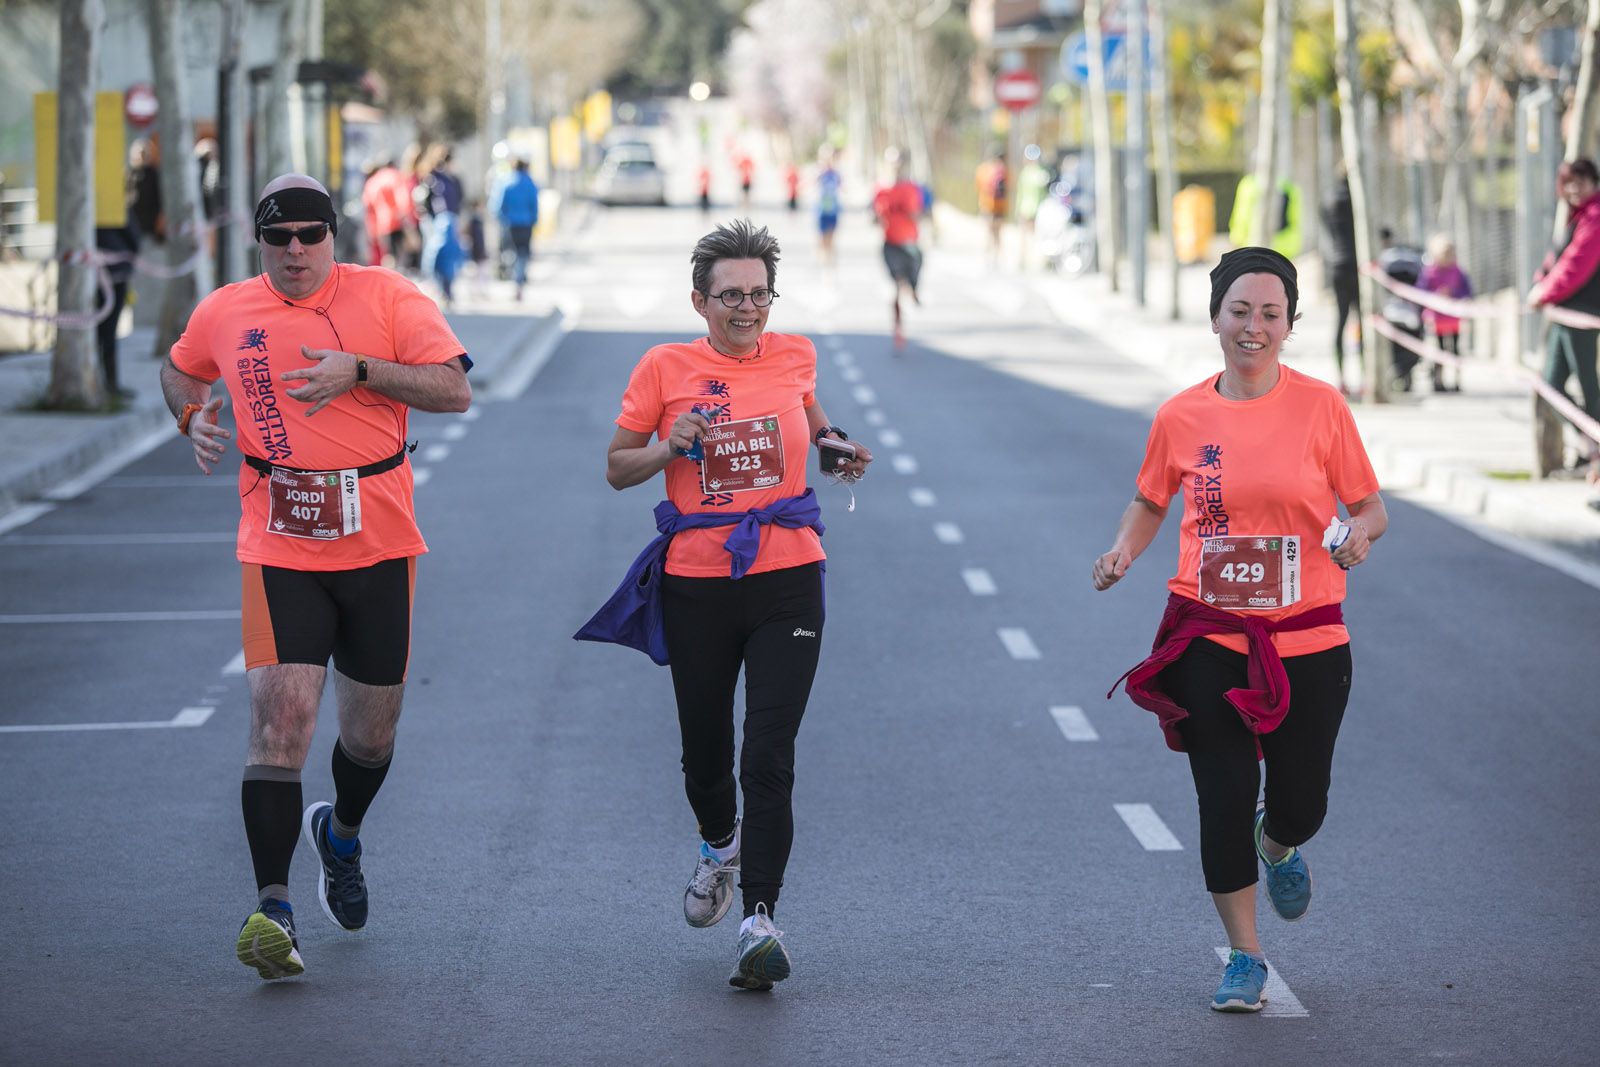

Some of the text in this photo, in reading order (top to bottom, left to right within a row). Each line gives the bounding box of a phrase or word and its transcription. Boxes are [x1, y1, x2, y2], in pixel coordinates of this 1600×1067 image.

[237, 358, 279, 460] MILLES 2018
[252, 356, 292, 460] VALLDOREIX
[714, 441, 747, 456] ANA
[750, 436, 774, 452] BEL
[730, 455, 762, 472] 323
[345, 475, 355, 494] 407
[753, 476, 780, 484] COMPLEX
[286, 489, 325, 504] JORDI
[1194, 474, 1207, 516] 2018
[1206, 474, 1229, 536] DOREIX
[291, 505, 320, 520] 407
[1287, 542, 1296, 562] 429
[1220, 562, 1264, 582] 429
